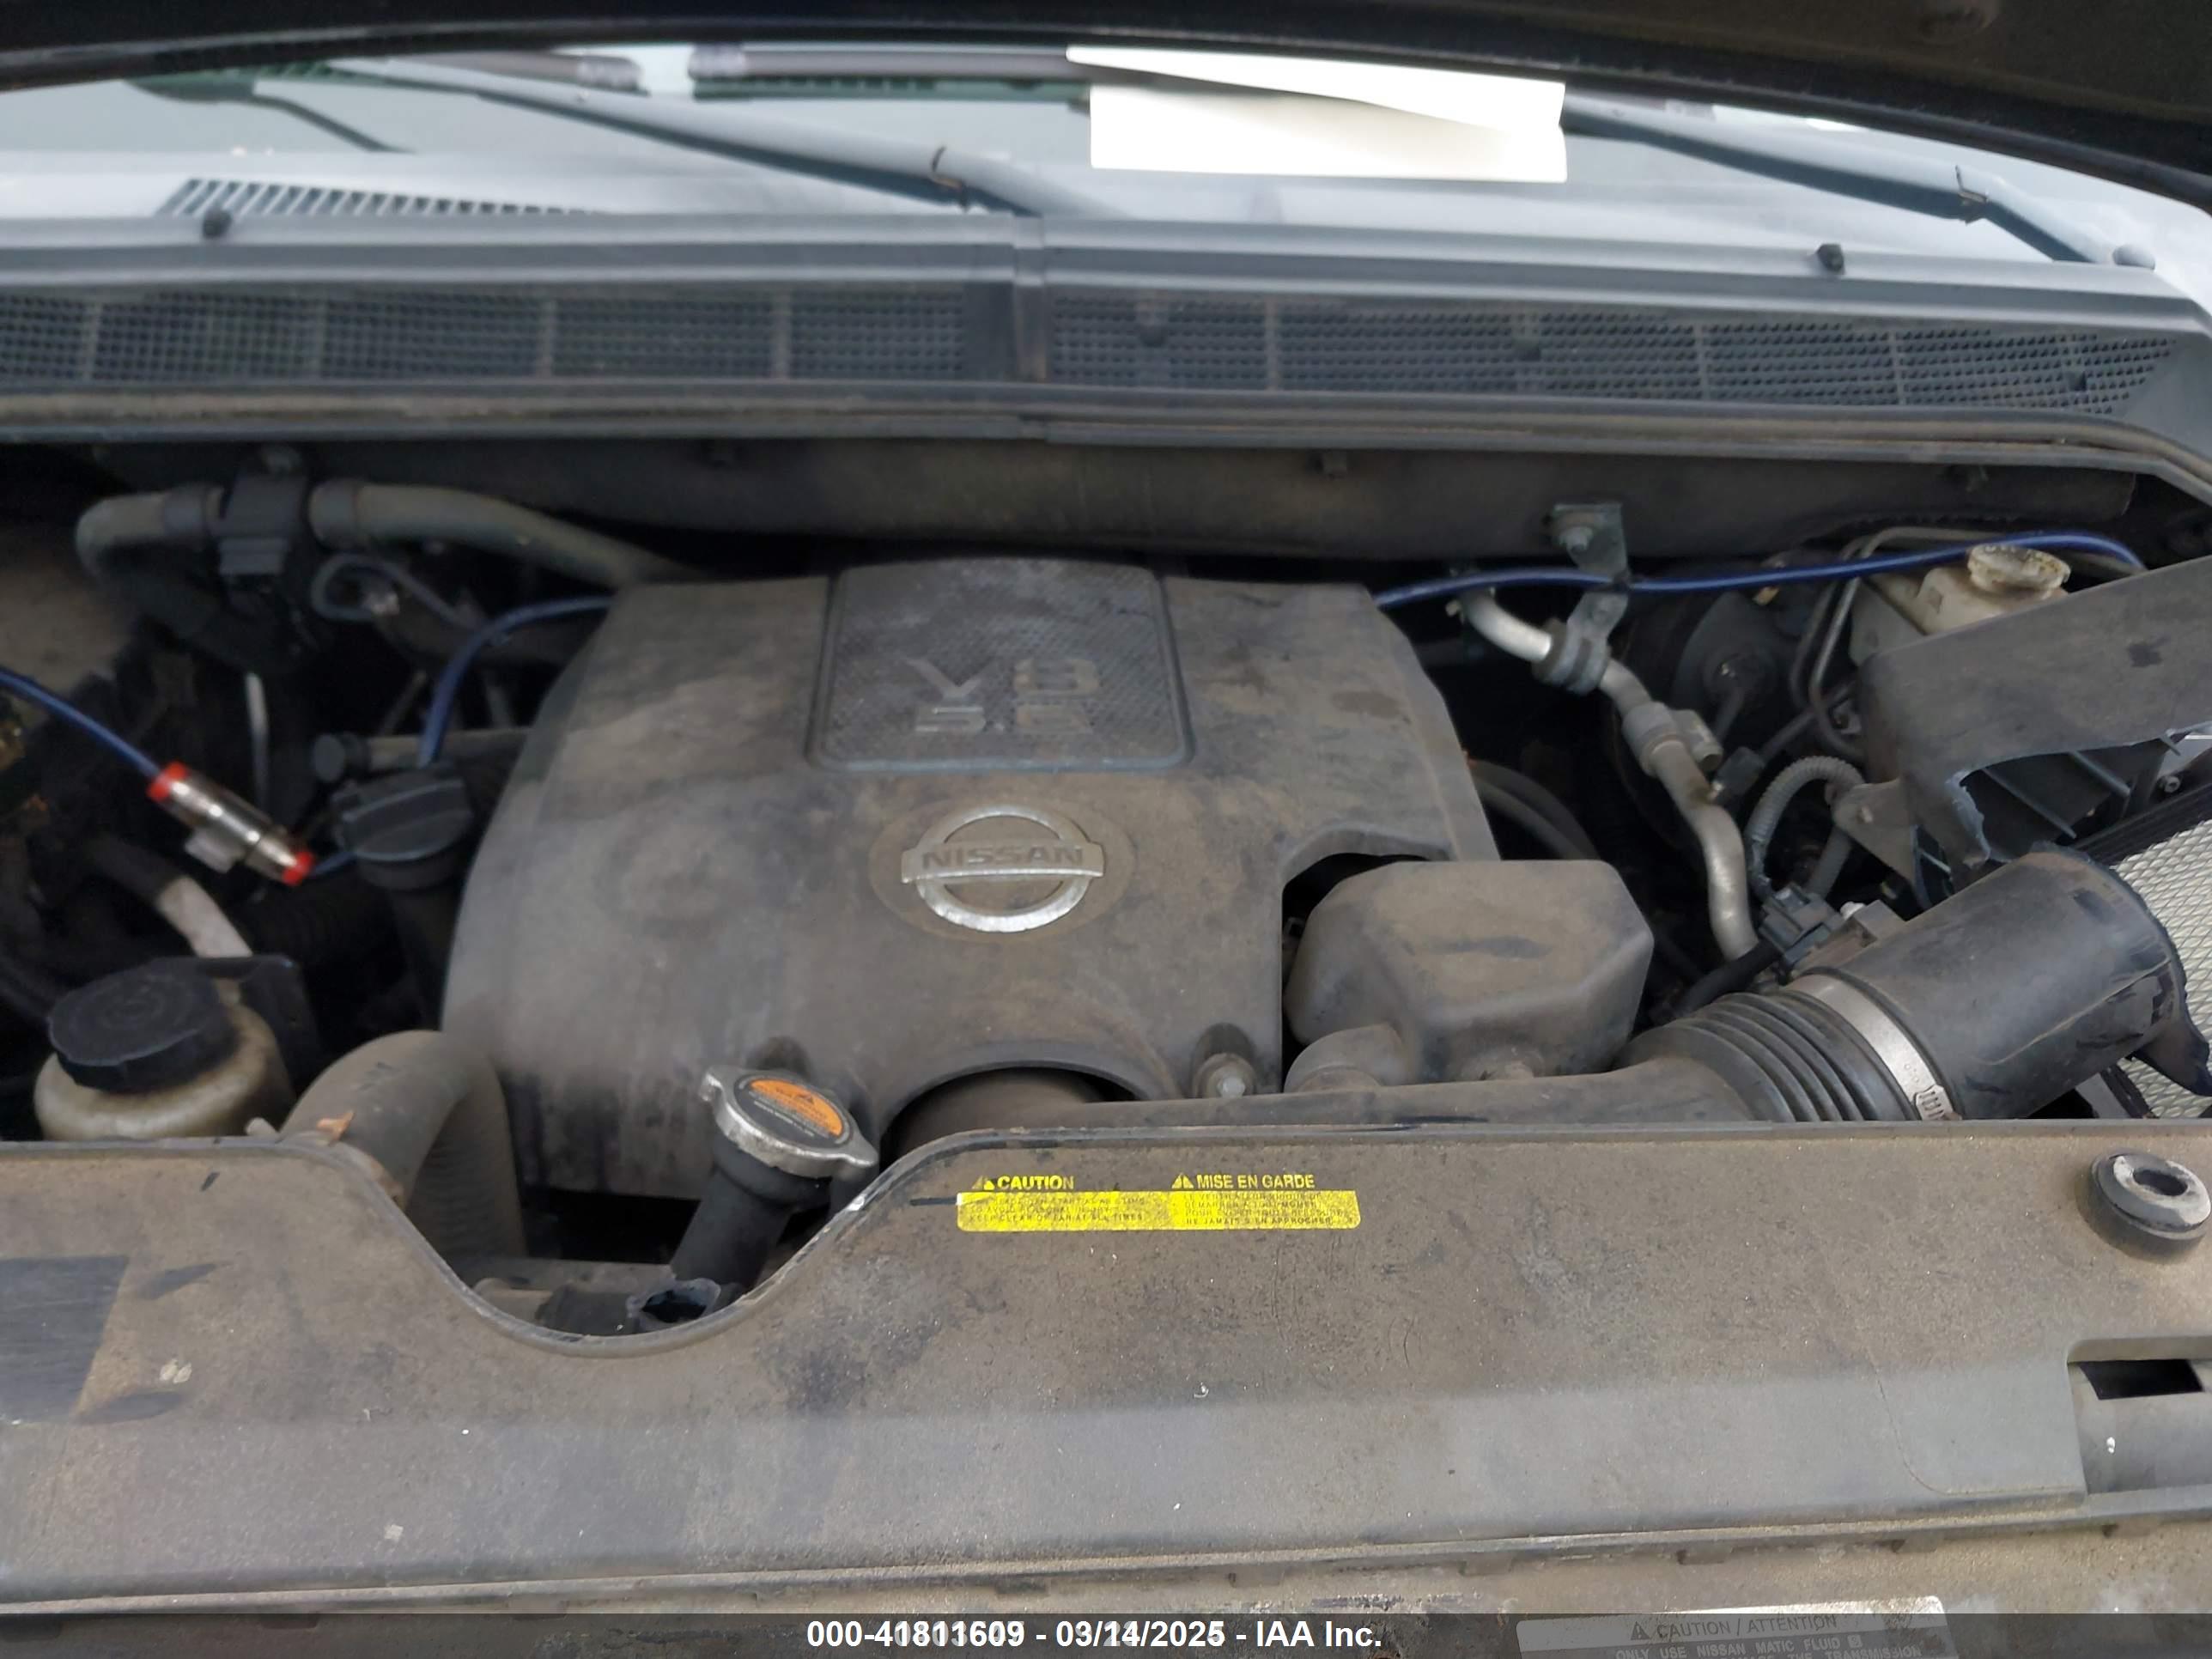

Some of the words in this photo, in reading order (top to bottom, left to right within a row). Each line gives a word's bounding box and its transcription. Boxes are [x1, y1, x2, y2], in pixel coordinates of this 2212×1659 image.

[921, 844, 1084, 870] NISSAN
[997, 1175, 1074, 1190] CAUTION
[1196, 1174, 1234, 1188] MISE
[1237, 1174, 1258, 1188] EN
[1261, 1173, 1316, 1188] GARDE
[1656, 1620, 1730, 1638] CAUTION
[1748, 1613, 1837, 1633] ATTENTION
[1615, 1648, 1650, 1659] ONLY
[1660, 1646, 1687, 1659] USE
[1697, 1642, 1747, 1658] NISSAN
[1755, 1639, 1795, 1654] MATIC
[1803, 1637, 1841, 1651] FLUID
